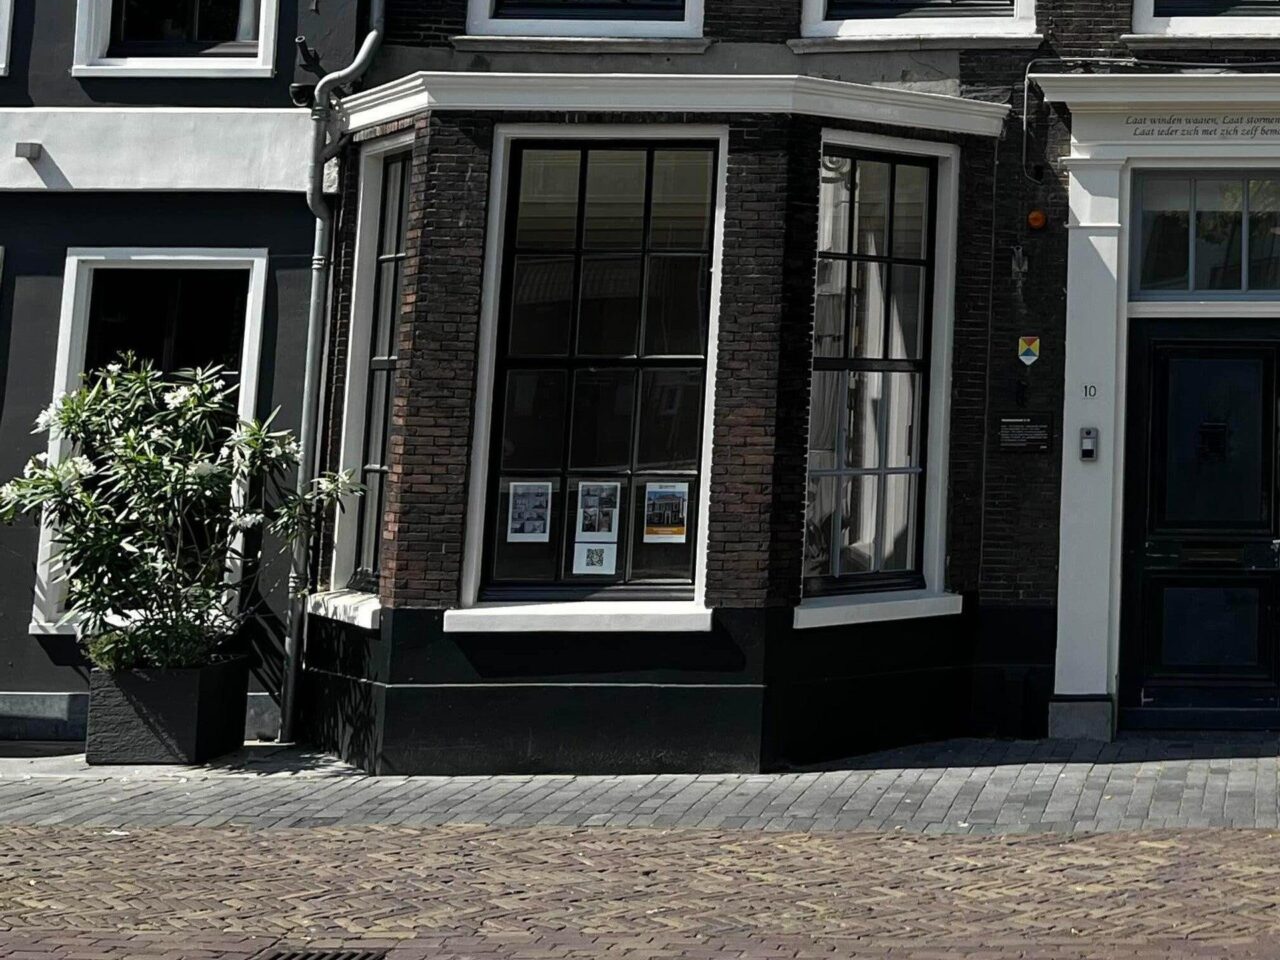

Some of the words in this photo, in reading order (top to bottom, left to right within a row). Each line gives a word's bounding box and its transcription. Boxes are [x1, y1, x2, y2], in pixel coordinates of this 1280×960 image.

[1125, 115, 1147, 125] Laat
[1150, 114, 1182, 125] winden
[1222, 115, 1244, 125] Laat
[1246, 116, 1280, 125] stormen
[1133, 126, 1155, 136] Laat
[1157, 126, 1180, 136] ieder
[1180, 125, 1199, 136] zich
[1201, 128, 1218, 136] met
[1220, 125, 1239, 136] zich
[1240, 125, 1261, 139] zelf
[1084, 384, 1097, 398] 10
